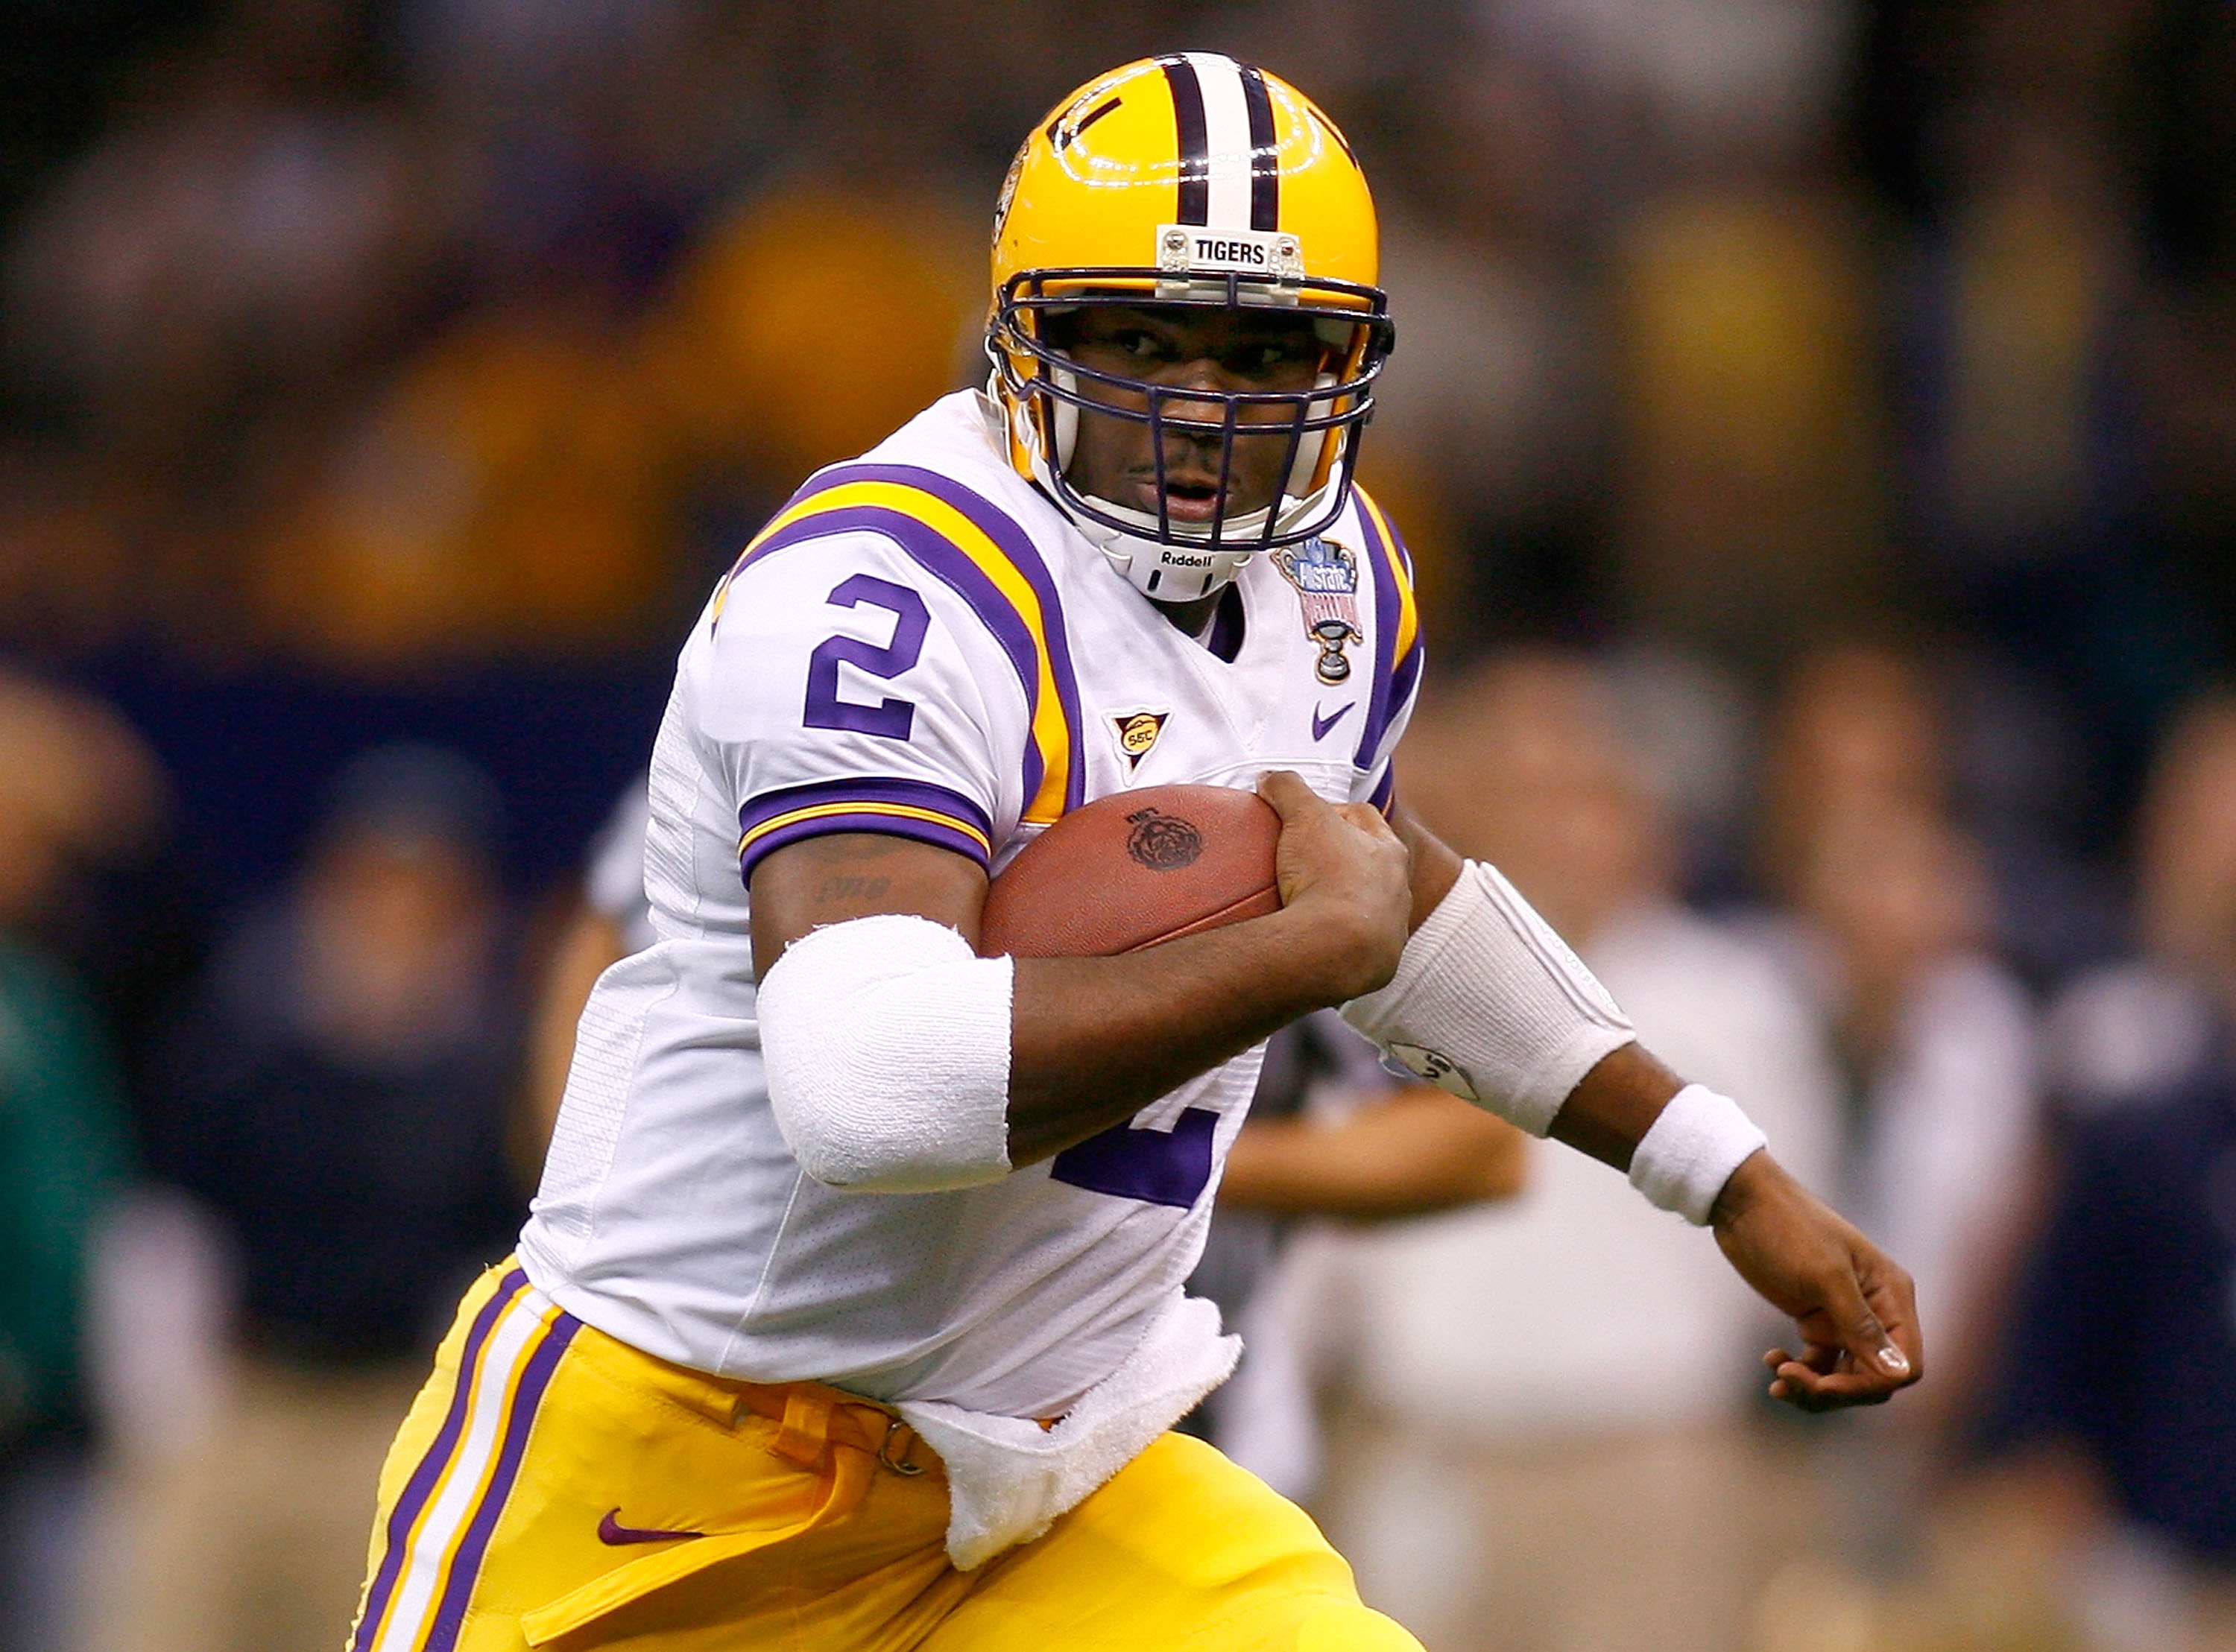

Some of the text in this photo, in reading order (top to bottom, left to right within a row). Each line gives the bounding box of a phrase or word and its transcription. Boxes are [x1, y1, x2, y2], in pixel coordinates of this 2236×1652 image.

[1196, 239, 1264, 265] TIGERS
[1161, 551, 1211, 567] Riddell
[802, 572, 932, 742] 2
[1128, 730, 1153, 747] SEC
